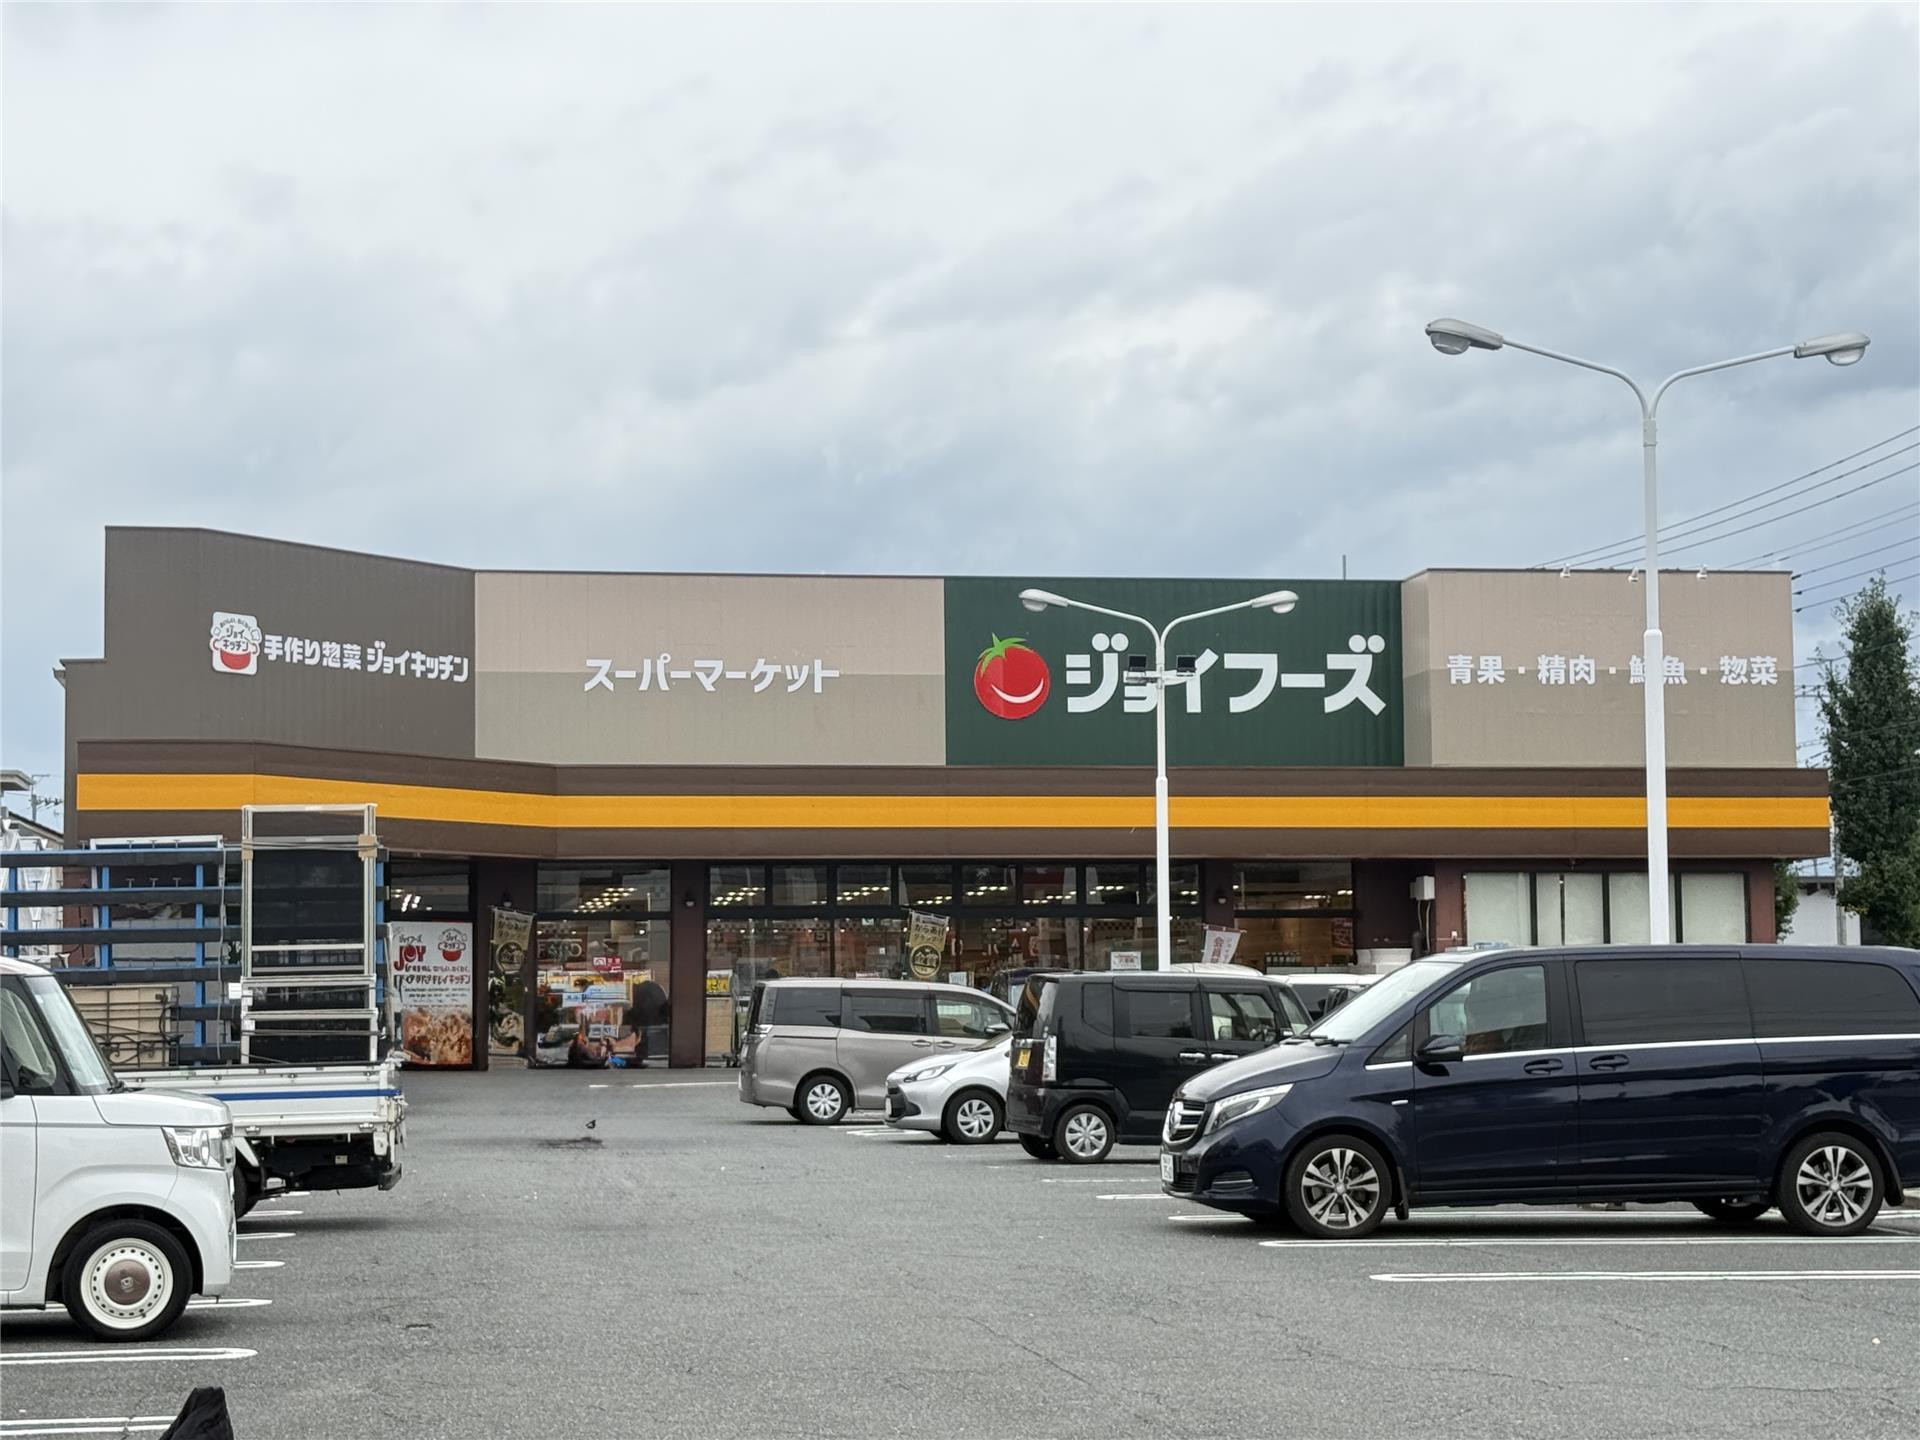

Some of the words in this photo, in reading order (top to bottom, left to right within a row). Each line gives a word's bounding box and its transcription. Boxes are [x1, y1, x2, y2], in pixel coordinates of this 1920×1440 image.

[264, 634, 361, 670] 手作り惣菜
[367, 640, 469, 682] ジョイキッチン
[584, 652, 840, 693] スーパーマーケット
[1066, 632, 1387, 716] ジョイフーズ
